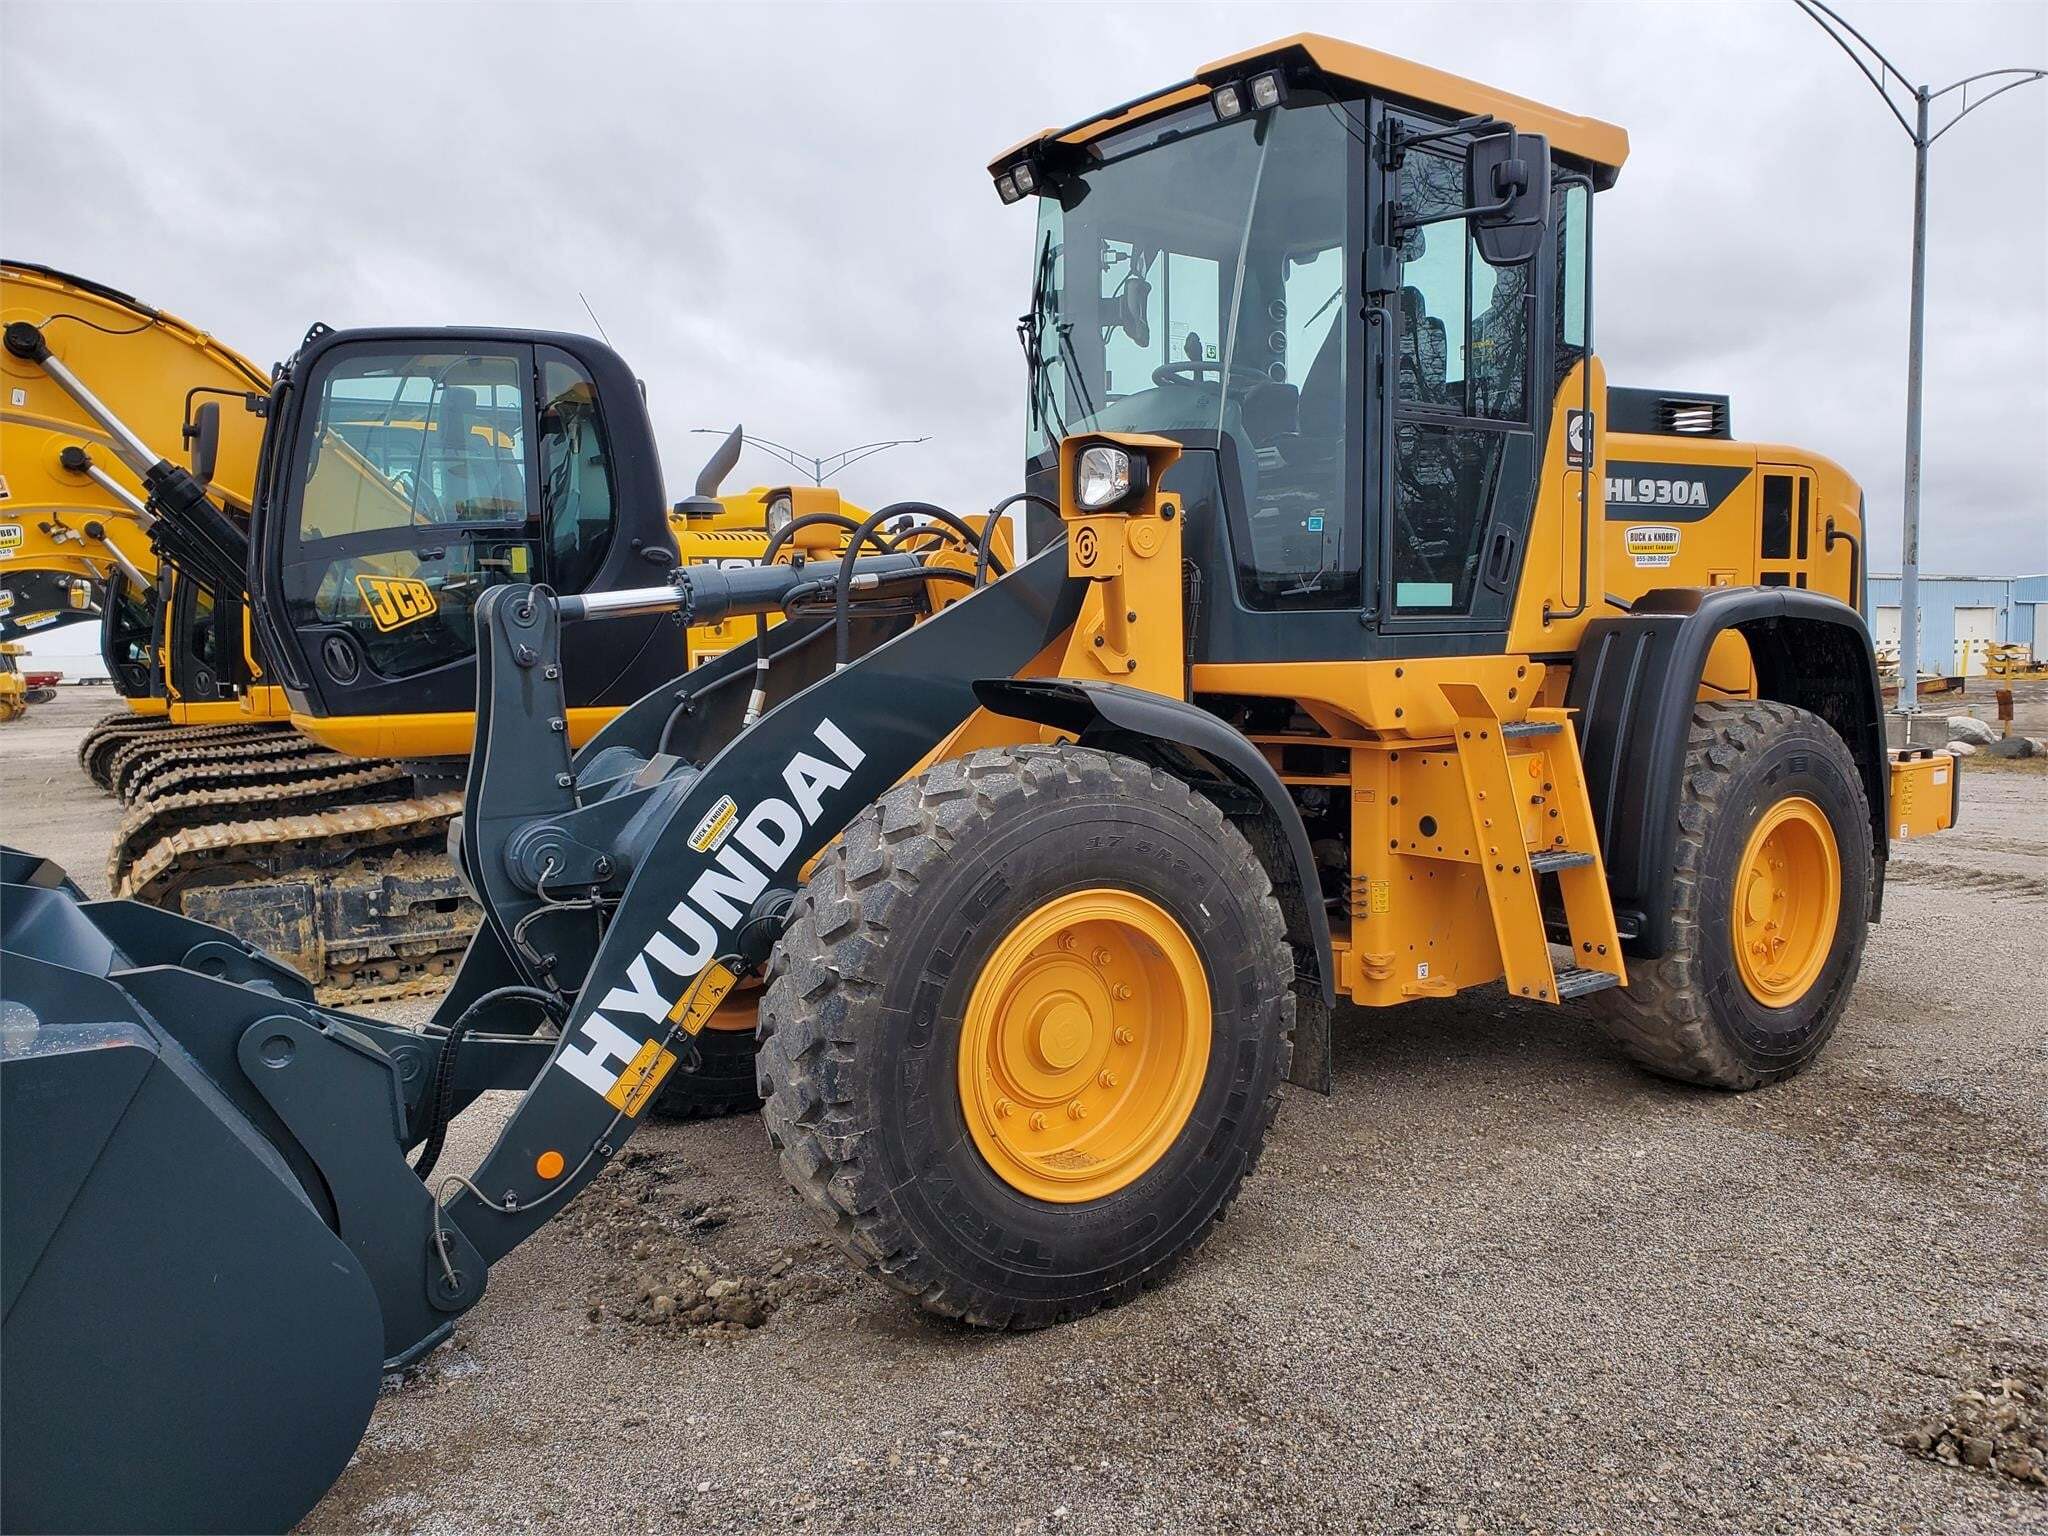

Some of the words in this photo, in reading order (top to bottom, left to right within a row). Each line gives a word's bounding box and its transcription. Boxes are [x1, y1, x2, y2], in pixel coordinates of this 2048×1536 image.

[1605, 478, 1708, 506] HL930A
[1630, 532, 1646, 542] BUCK
[1648, 533, 1652, 542] &
[1654, 532, 1677, 542] KNOBBY
[370, 580, 432, 625] JCB
[692, 828, 708, 845] BUCK
[710, 800, 729, 824] KNOBBY
[555, 717, 867, 1097] HYUNDAI
